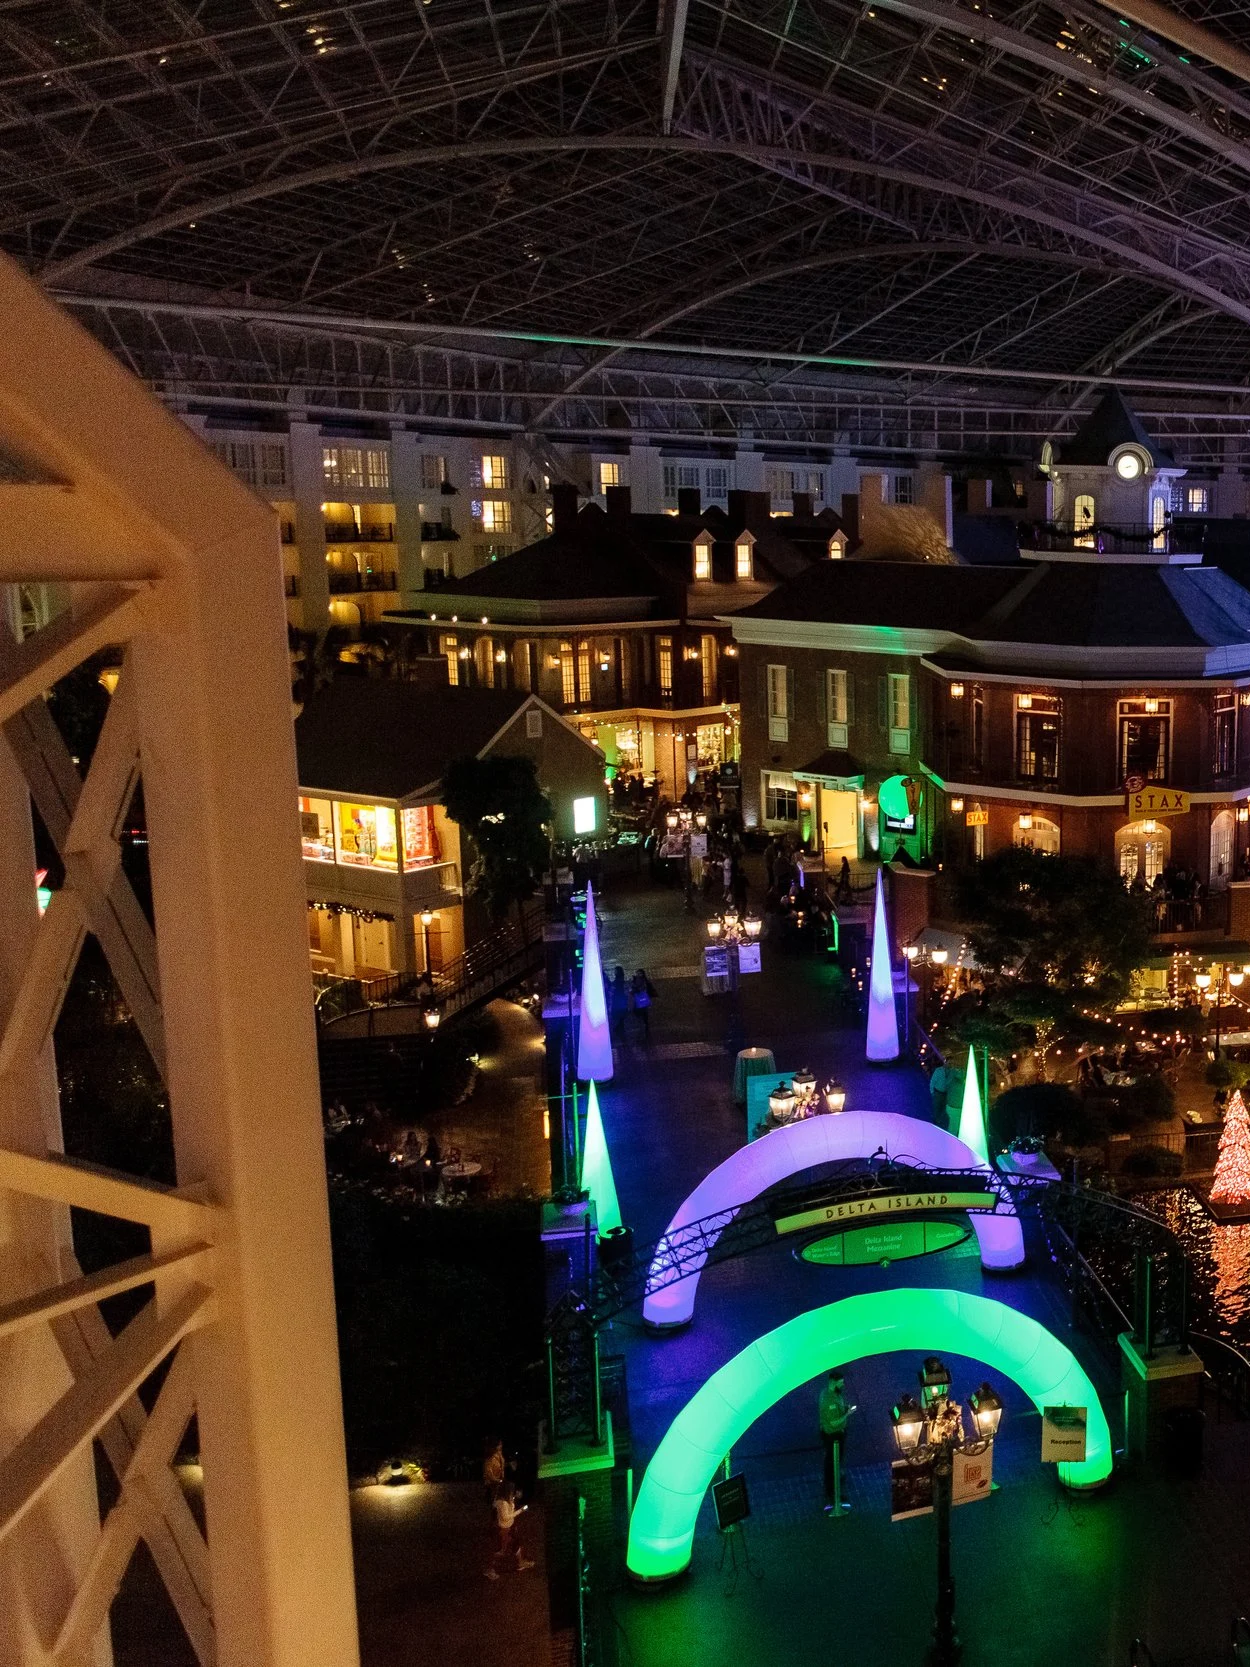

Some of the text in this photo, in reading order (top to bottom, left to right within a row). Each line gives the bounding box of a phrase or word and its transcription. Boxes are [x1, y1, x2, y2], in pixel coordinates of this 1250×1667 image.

[1135, 794, 1183, 808] STAX
[967, 812, 988, 823] STAX
[826, 1195, 948, 1219] DELTA ISLAND
[865, 1232, 903, 1245] Delta Island
